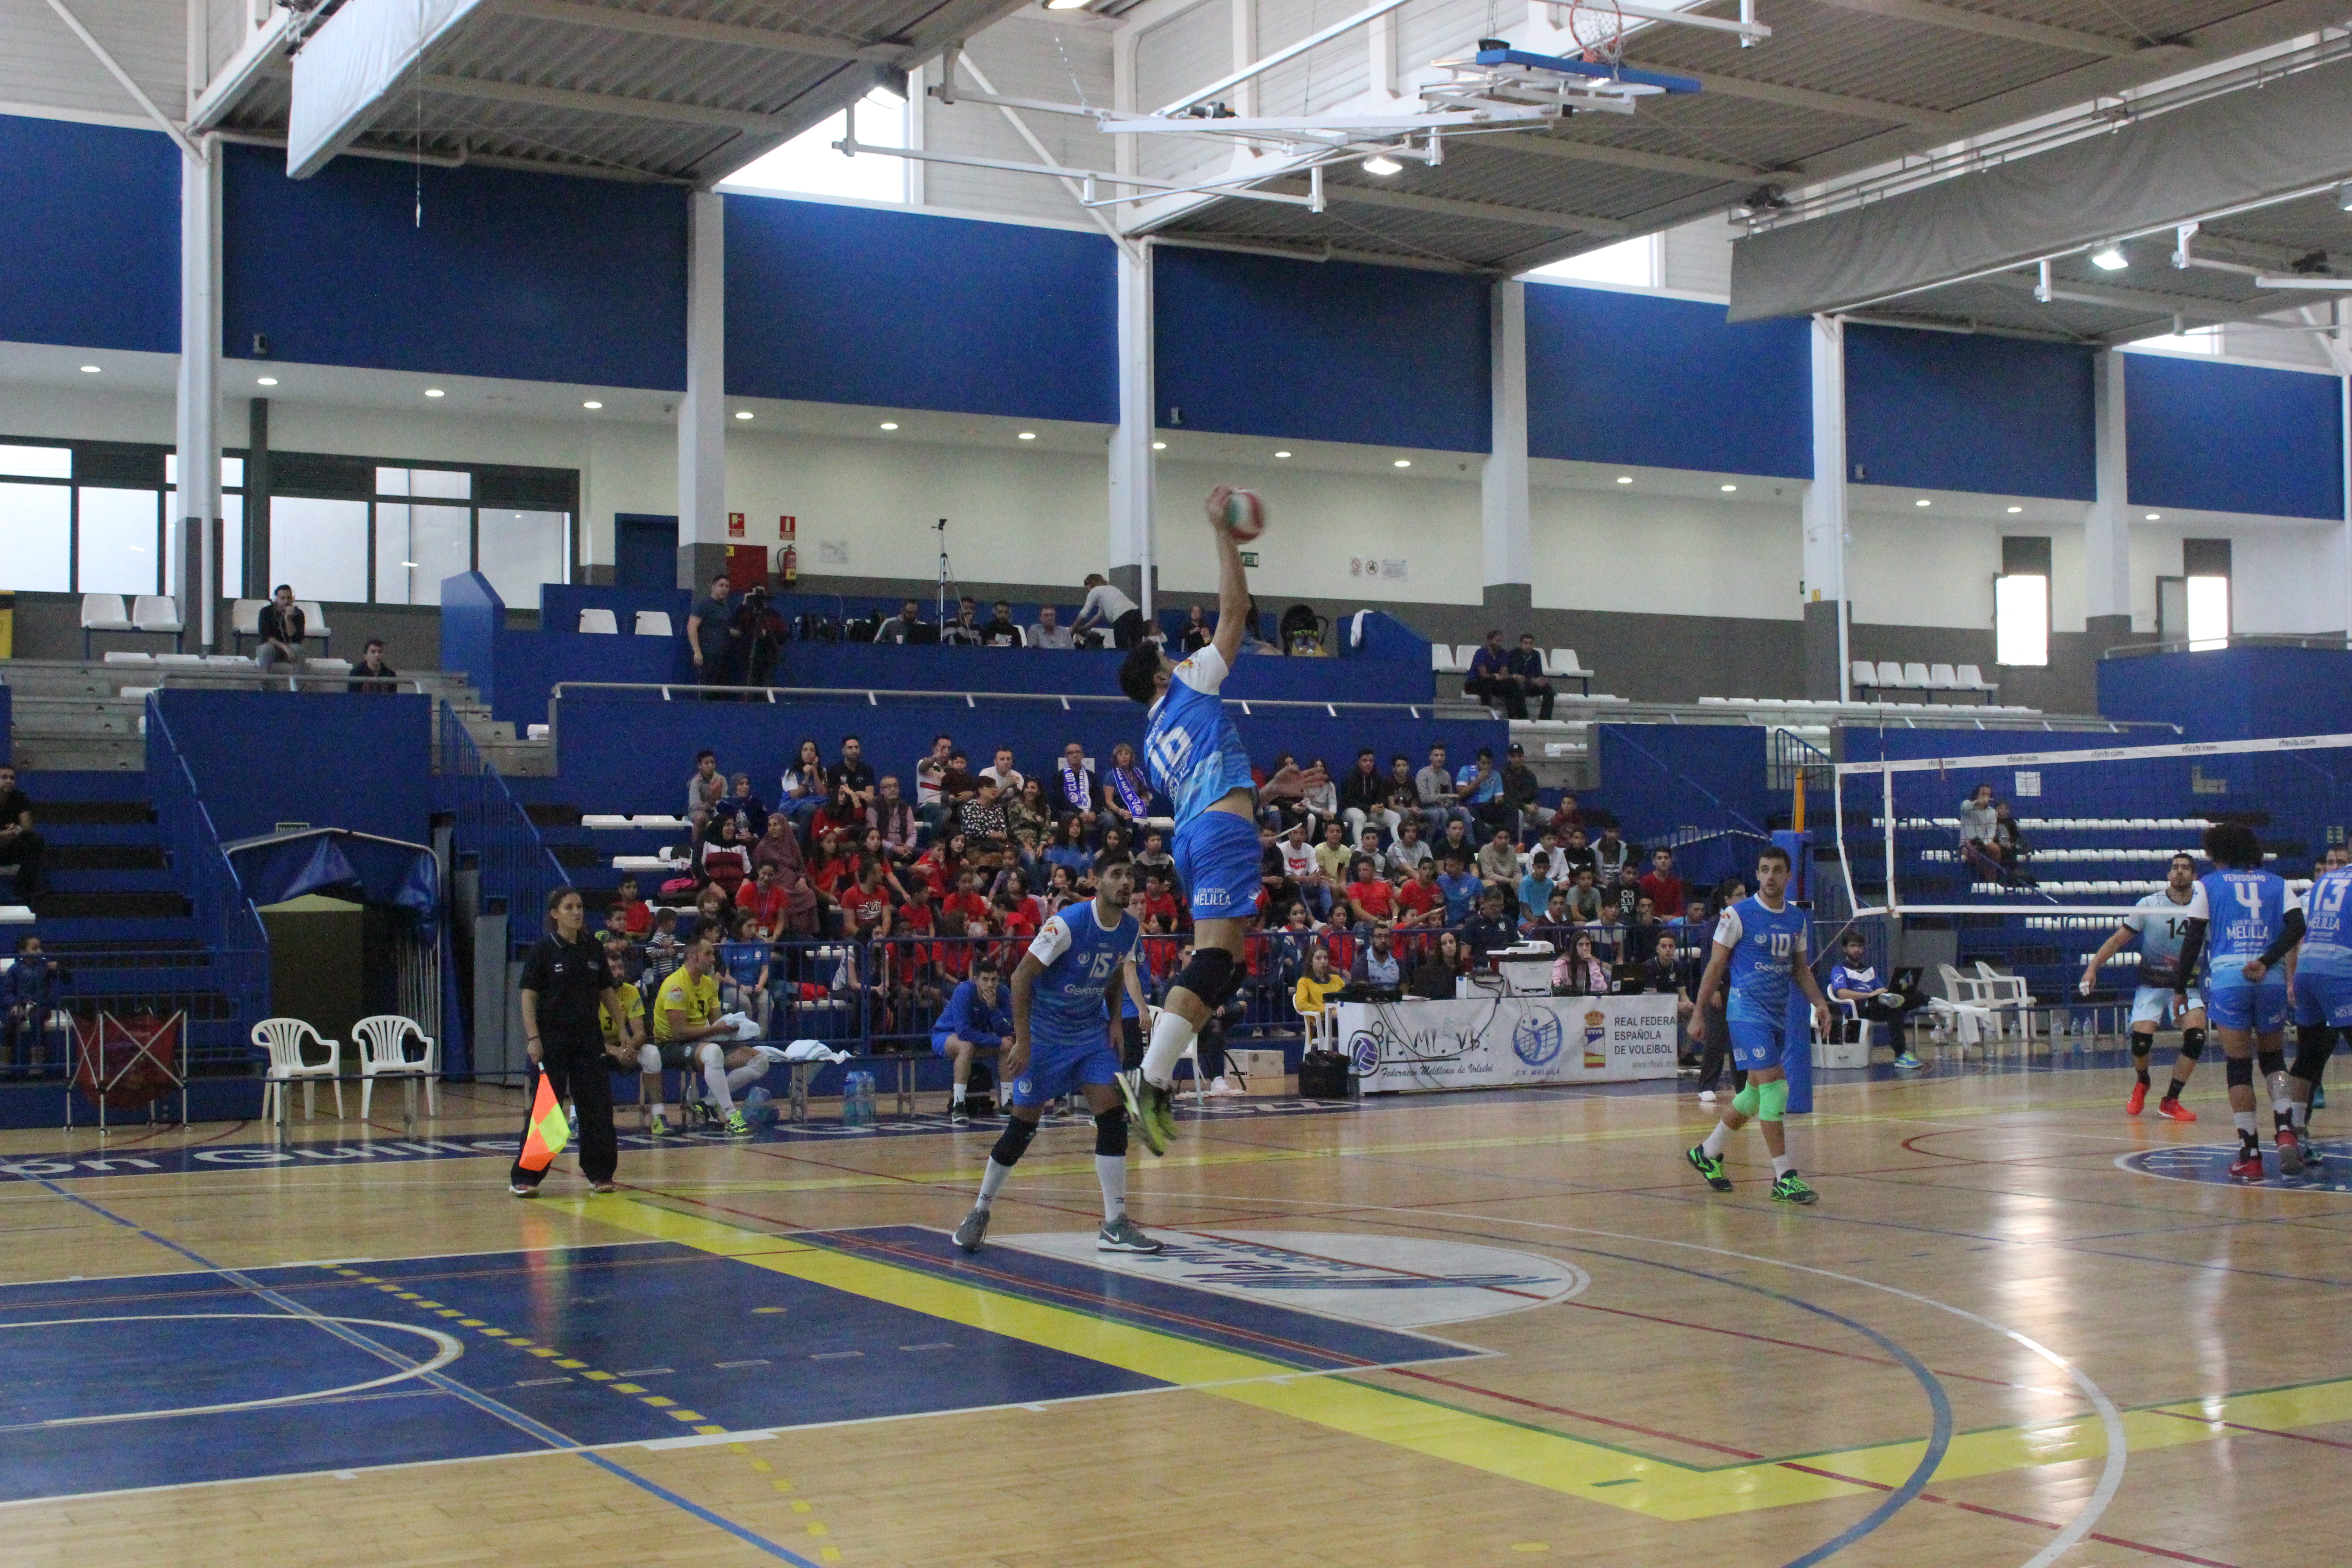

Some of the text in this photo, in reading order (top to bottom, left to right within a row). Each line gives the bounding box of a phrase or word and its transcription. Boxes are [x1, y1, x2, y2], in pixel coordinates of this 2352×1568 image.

[2182, 745, 2217, 753] rfevb.com
[2279, 739, 2316, 747] rfevb.com
[2007, 755, 2038, 763] rfevb.com
[2092, 749, 2125, 757] rfevb.com
[1928, 759, 1957, 767] rfev.com
[1065, 772, 1077, 791] CLUB
[1194, 893, 1231, 906] MELILLA
[2234, 882, 2262, 919] 4
[2314, 879, 2352, 912] 13
[2166, 917, 2187, 939] 14
[2226, 925, 2269, 940] MELILLA
[1771, 933, 1791, 956] 10
[1089, 953, 1112, 978] 15
[604, 1016, 612, 1030] 3
[1614, 1016, 1676, 1026] REAL FEDERA
[1614, 1029, 1661, 1040] ESPAÑOLA
[1614, 1045, 1672, 1055] DE VOLEIBOL
[1468, 1063, 1493, 1073] Voleibol
[194, 1132, 756, 1163] Guillemo
